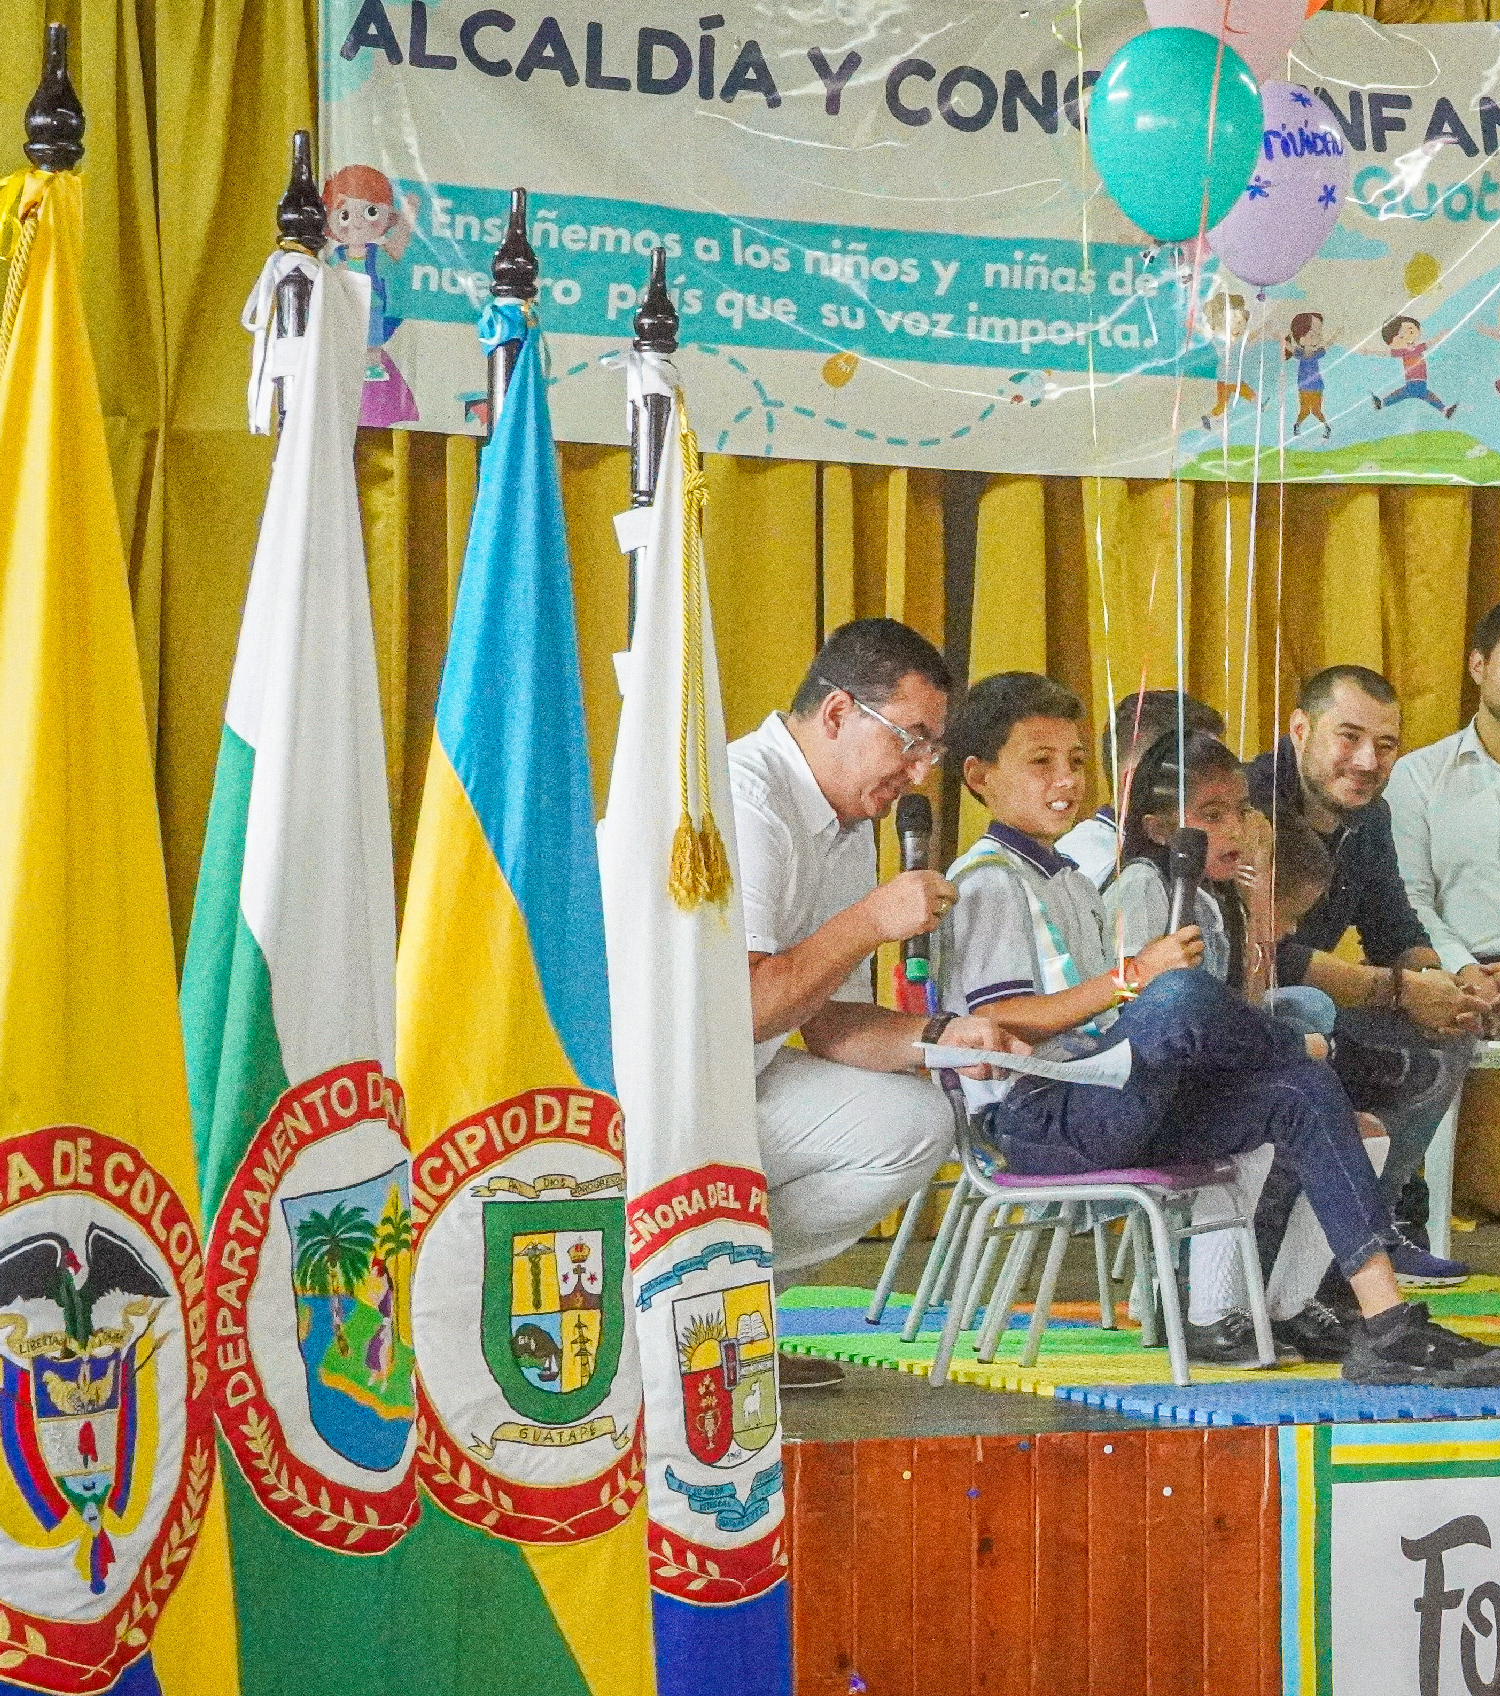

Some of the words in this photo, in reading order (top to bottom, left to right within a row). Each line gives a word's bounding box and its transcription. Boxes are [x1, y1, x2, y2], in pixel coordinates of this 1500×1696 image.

[340, 0, 782, 109] ALCALDÍA
[807, 46, 863, 116] Y
[432, 198, 682, 257] Ensñemos
[694, 235, 721, 262] a
[732, 228, 791, 272] los
[804, 239, 919, 283] niños
[932, 257, 961, 297] y
[984, 250, 1097, 294] niñas
[1107, 257, 1160, 298] de
[411, 264, 582, 305] nuero
[715, 289, 798, 330] que
[820, 302, 866, 331] su
[876, 310, 955, 338] voz
[966, 302, 1156, 355] importa.
[533, 1094, 594, 1136] DE
[53, 1136, 93, 1187] DE
[707, 1181, 742, 1209] DEL
[216, 1078, 358, 1407] DEPARTAMENTO
